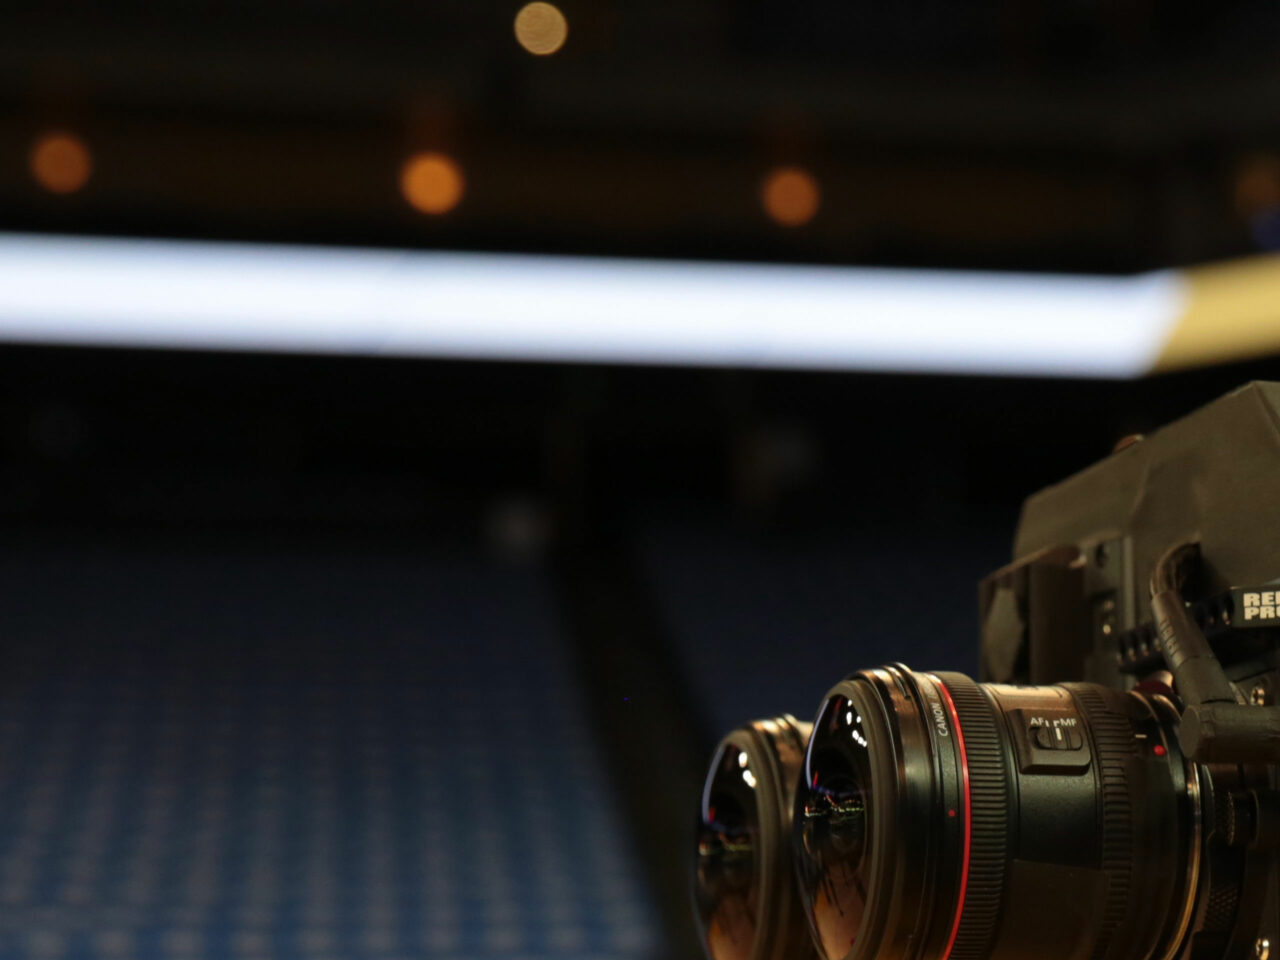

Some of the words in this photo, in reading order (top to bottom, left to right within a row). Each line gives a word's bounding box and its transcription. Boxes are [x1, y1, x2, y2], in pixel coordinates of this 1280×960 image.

[931, 702, 949, 737] CANON
[1030, 717, 1044, 726] AF
[1060, 718, 1077, 727] MF
